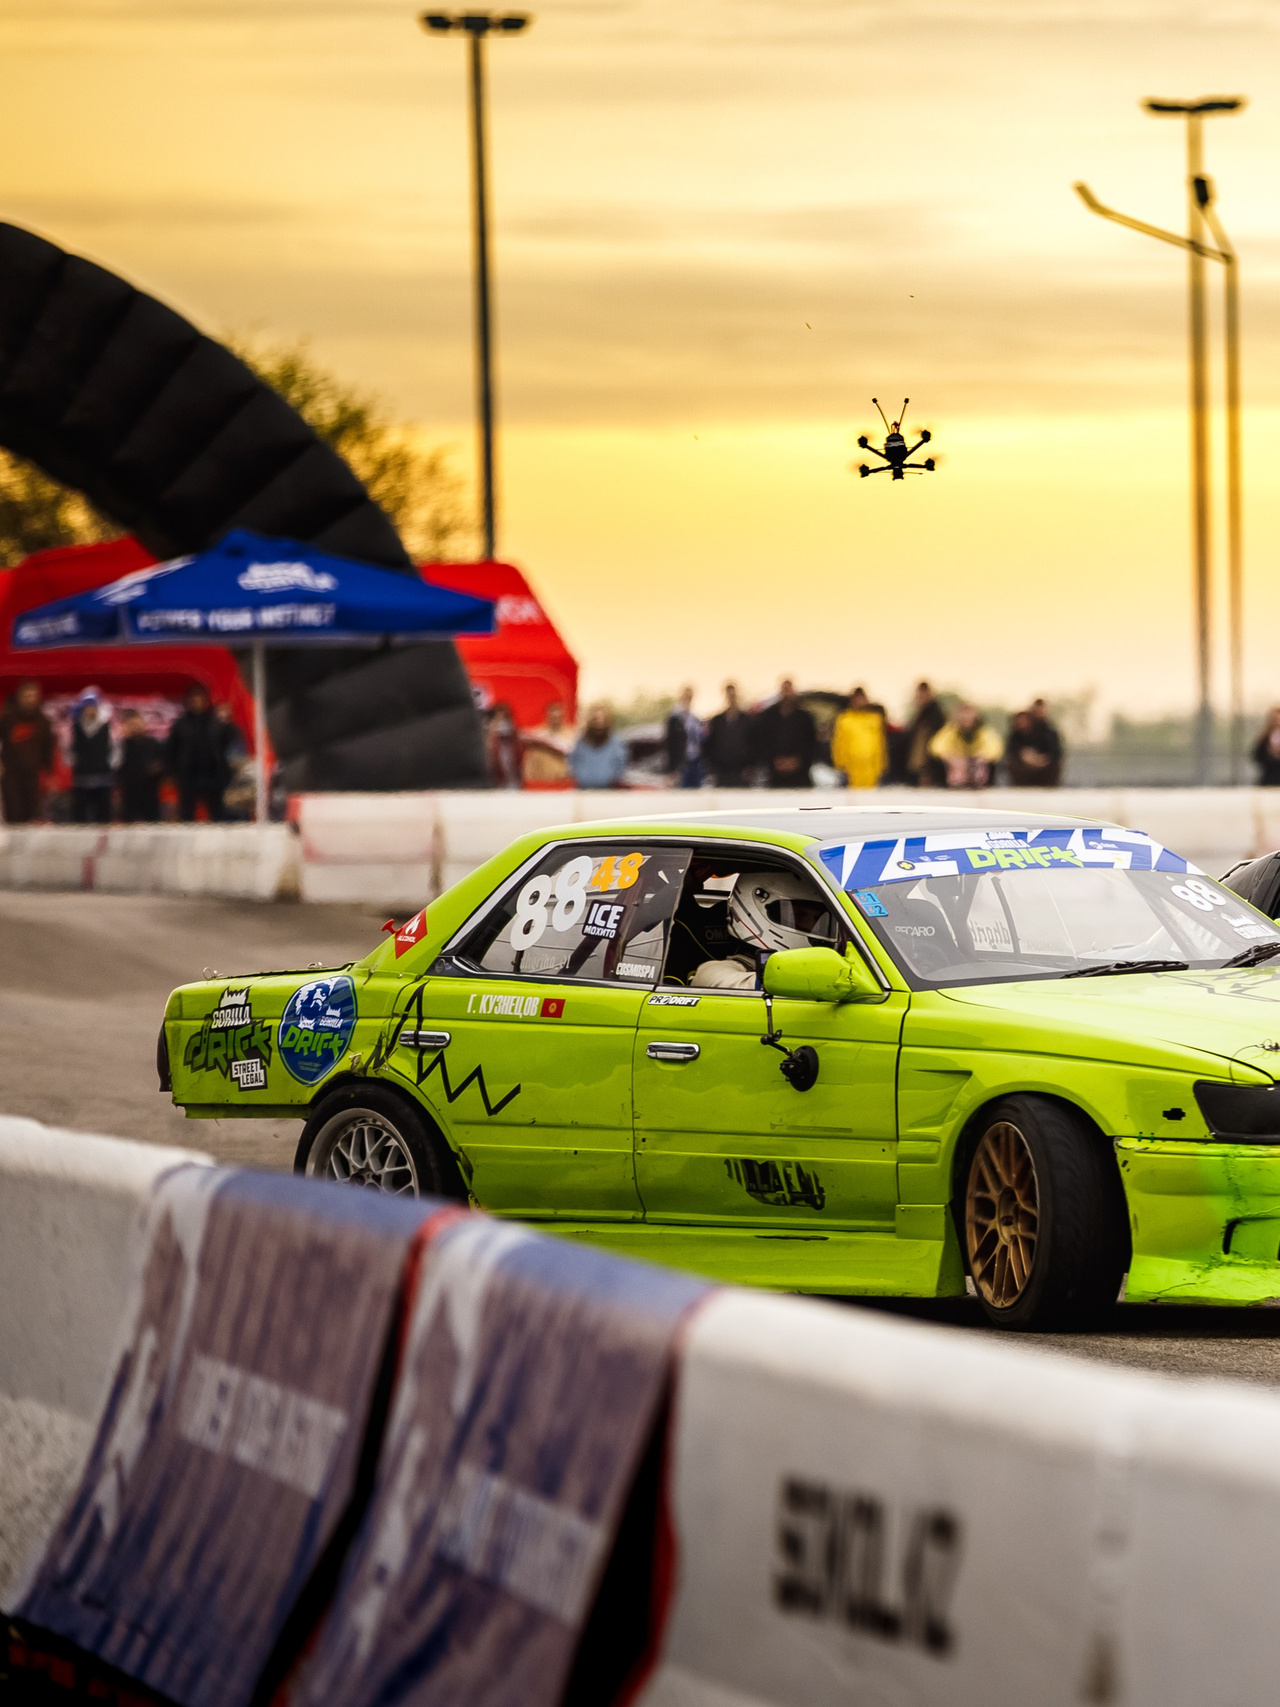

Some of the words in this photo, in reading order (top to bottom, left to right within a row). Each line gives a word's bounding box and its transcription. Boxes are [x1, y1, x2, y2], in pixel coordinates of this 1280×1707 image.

[966, 846, 1083, 868] DRIFT
[591, 852, 643, 892] 48
[510, 856, 593, 951] 88
[1171, 879, 1226, 912] 88
[588, 903, 624, 929] ICE
[583, 925, 616, 939] МОХИТО
[616, 962, 656, 979] COSMOSPA
[212, 1006, 251, 1029] GORILLA
[467, 994, 480, 1014] Г.
[479, 994, 540, 1019] КУЗНЕЦОВ
[281, 1025, 345, 1060] DRIFT
[234, 1060, 259, 1076] STREET
[241, 1072, 264, 1086] LEGAL
